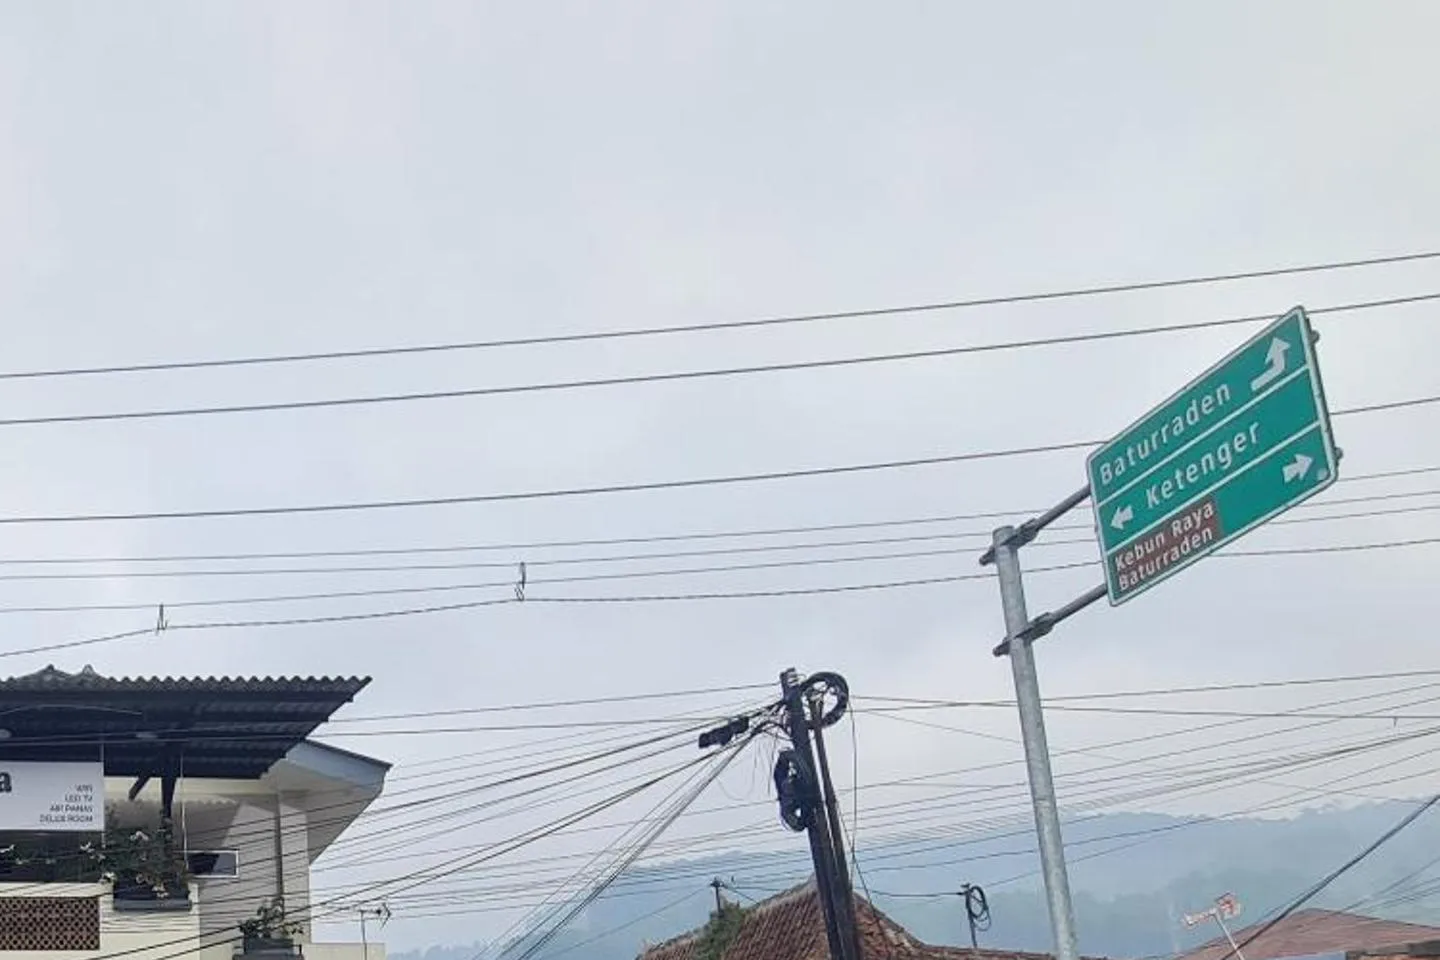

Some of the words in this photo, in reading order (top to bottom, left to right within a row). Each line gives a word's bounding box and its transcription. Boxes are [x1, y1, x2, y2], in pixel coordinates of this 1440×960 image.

[1100, 382, 1231, 486] Baturraden
[1146, 422, 1260, 509] Ketenger
[1115, 532, 1165, 572] Kebun
[1172, 503, 1215, 539] Raya
[1118, 527, 1213, 591] Baturraden
